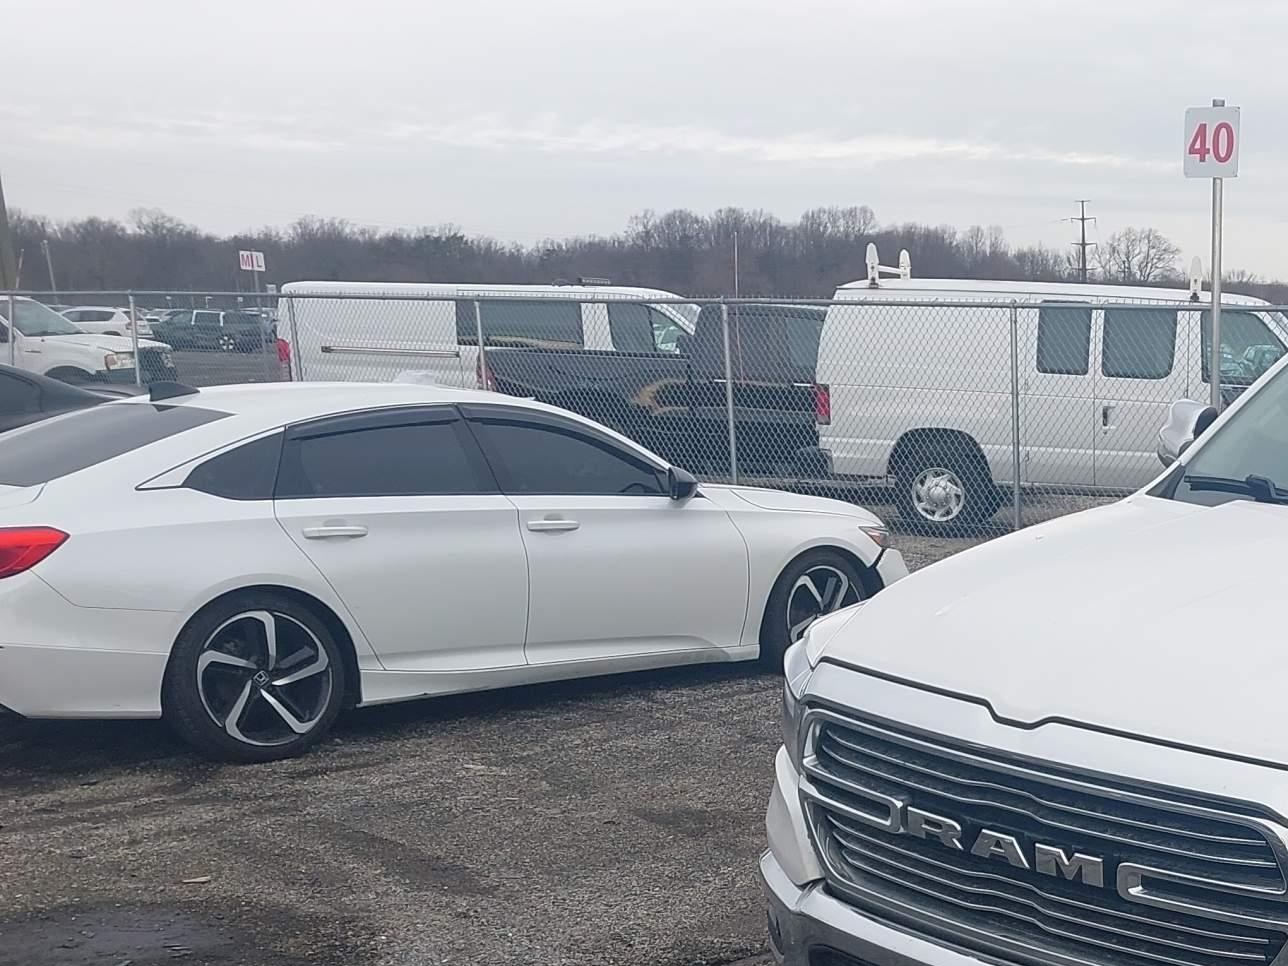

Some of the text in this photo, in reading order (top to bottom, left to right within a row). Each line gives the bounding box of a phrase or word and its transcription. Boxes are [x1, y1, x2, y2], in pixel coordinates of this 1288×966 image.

[1188, 121, 1234, 163] 40
[241, 254, 251, 268] M
[256, 254, 263, 268] L
[907, 805, 1104, 888] RAM
